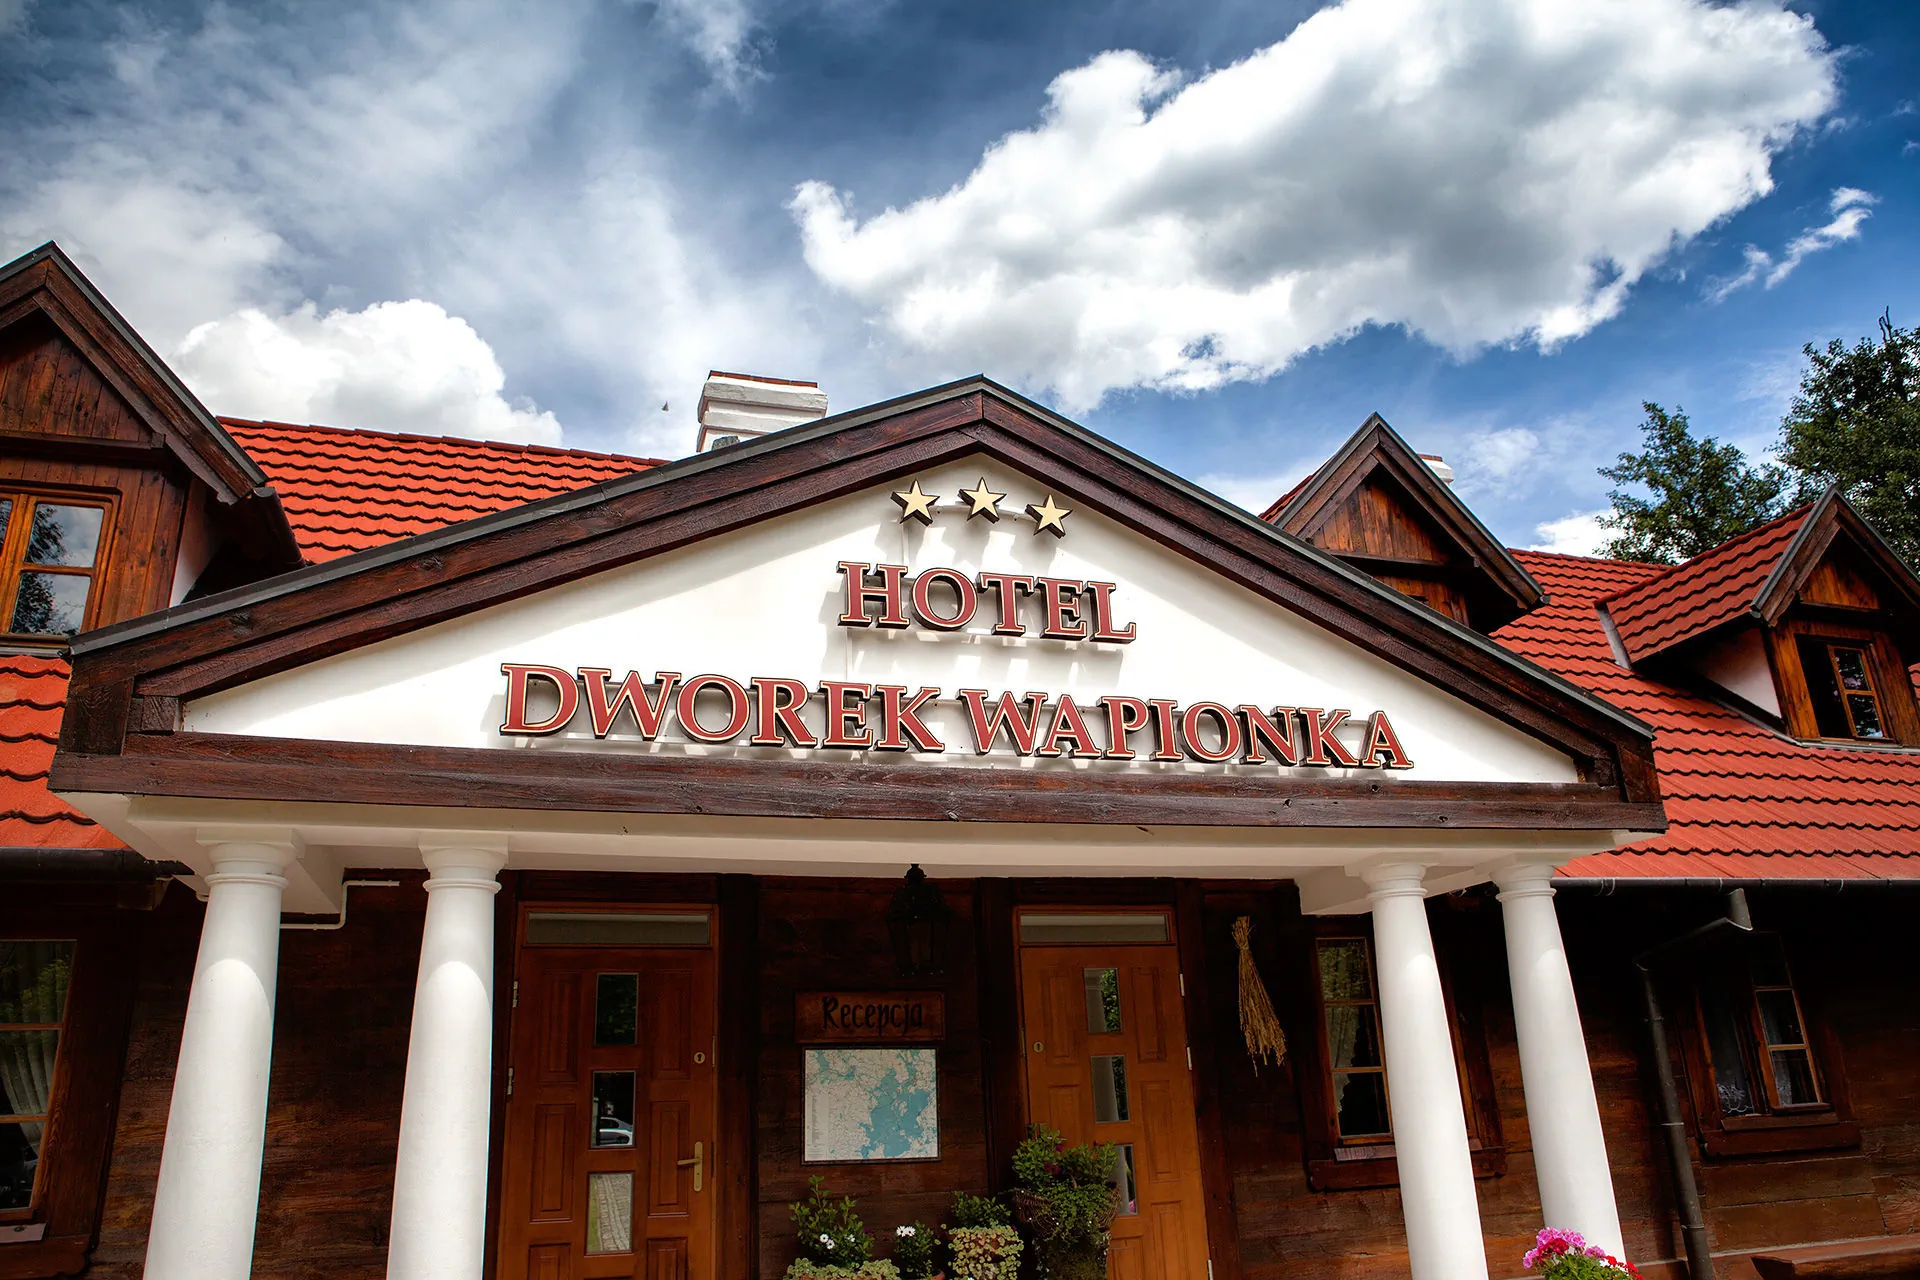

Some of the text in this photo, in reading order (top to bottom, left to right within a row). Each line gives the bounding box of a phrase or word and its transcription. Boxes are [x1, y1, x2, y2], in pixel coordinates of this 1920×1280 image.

[836, 561, 1137, 643] HOTEL
[500, 663, 1414, 770] DWOREK WAPIONKA
[821, 996, 923, 1037] Recepcja
